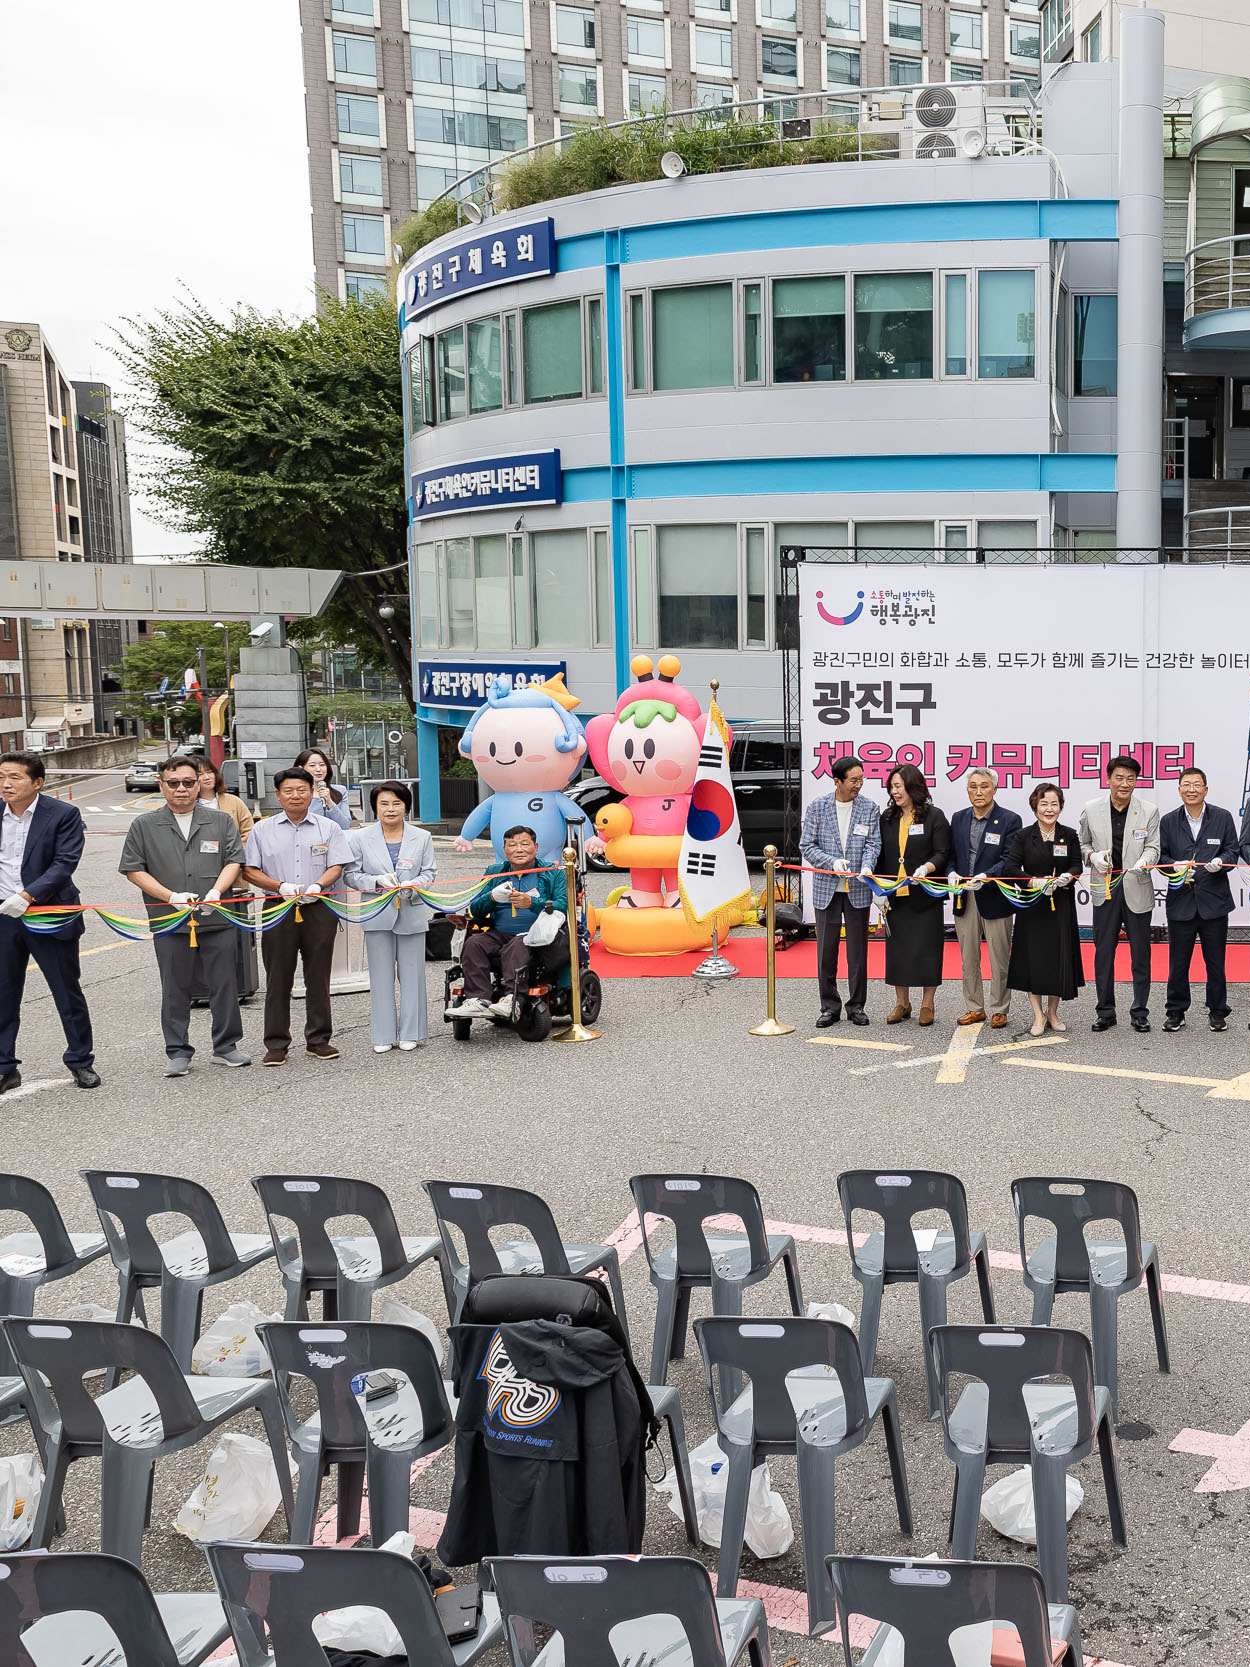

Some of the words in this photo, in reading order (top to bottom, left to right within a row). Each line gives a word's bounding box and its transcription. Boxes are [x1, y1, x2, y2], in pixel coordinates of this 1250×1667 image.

[417, 234, 534, 297] 광진구체육회
[424, 464, 540, 505] 광진구체육인커뮤니티센터
[870, 589, 901, 604] 소통하며
[902, 589, 936, 605] 발전하는
[869, 602, 936, 627] 행복광진
[812, 651, 894, 668] 광진구민의
[899, 651, 950, 668] 화합과
[954, 651, 991, 669] 소통,
[996, 651, 1046, 669] 모두가
[1052, 652, 1084, 669] 함께
[1090, 652, 1140, 669] 즐기는
[1145, 652, 1195, 669] 건강한
[1200, 652, 1250, 669] 놀이터
[812, 680, 937, 726] 광진구
[811, 740, 936, 788] 체육인
[945, 740, 1196, 790] 커뮤니티센터
[527, 797, 544, 812] G
[661, 798, 676, 811] J
[496, 1431, 523, 1443] SPORTS
